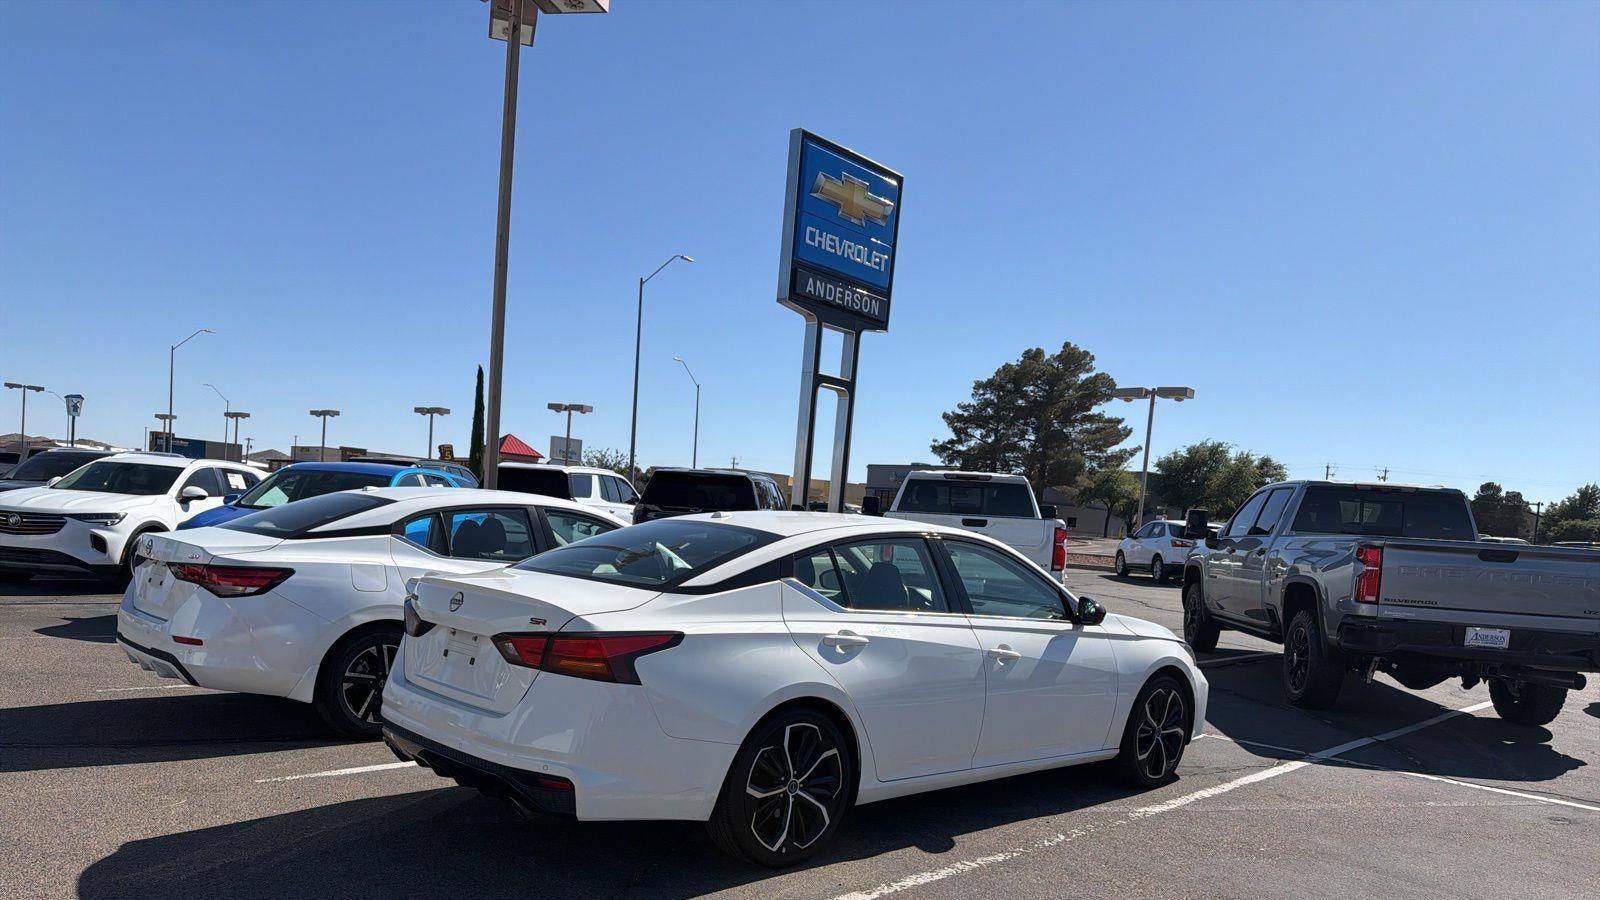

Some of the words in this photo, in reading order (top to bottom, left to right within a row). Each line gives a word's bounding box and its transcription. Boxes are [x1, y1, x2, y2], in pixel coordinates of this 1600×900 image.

[805, 226, 888, 272] CHEVROLET
[806, 277, 879, 316] ANDERSON
[1384, 597, 1438, 605] SILVERADO
[529, 617, 547, 626] SR
